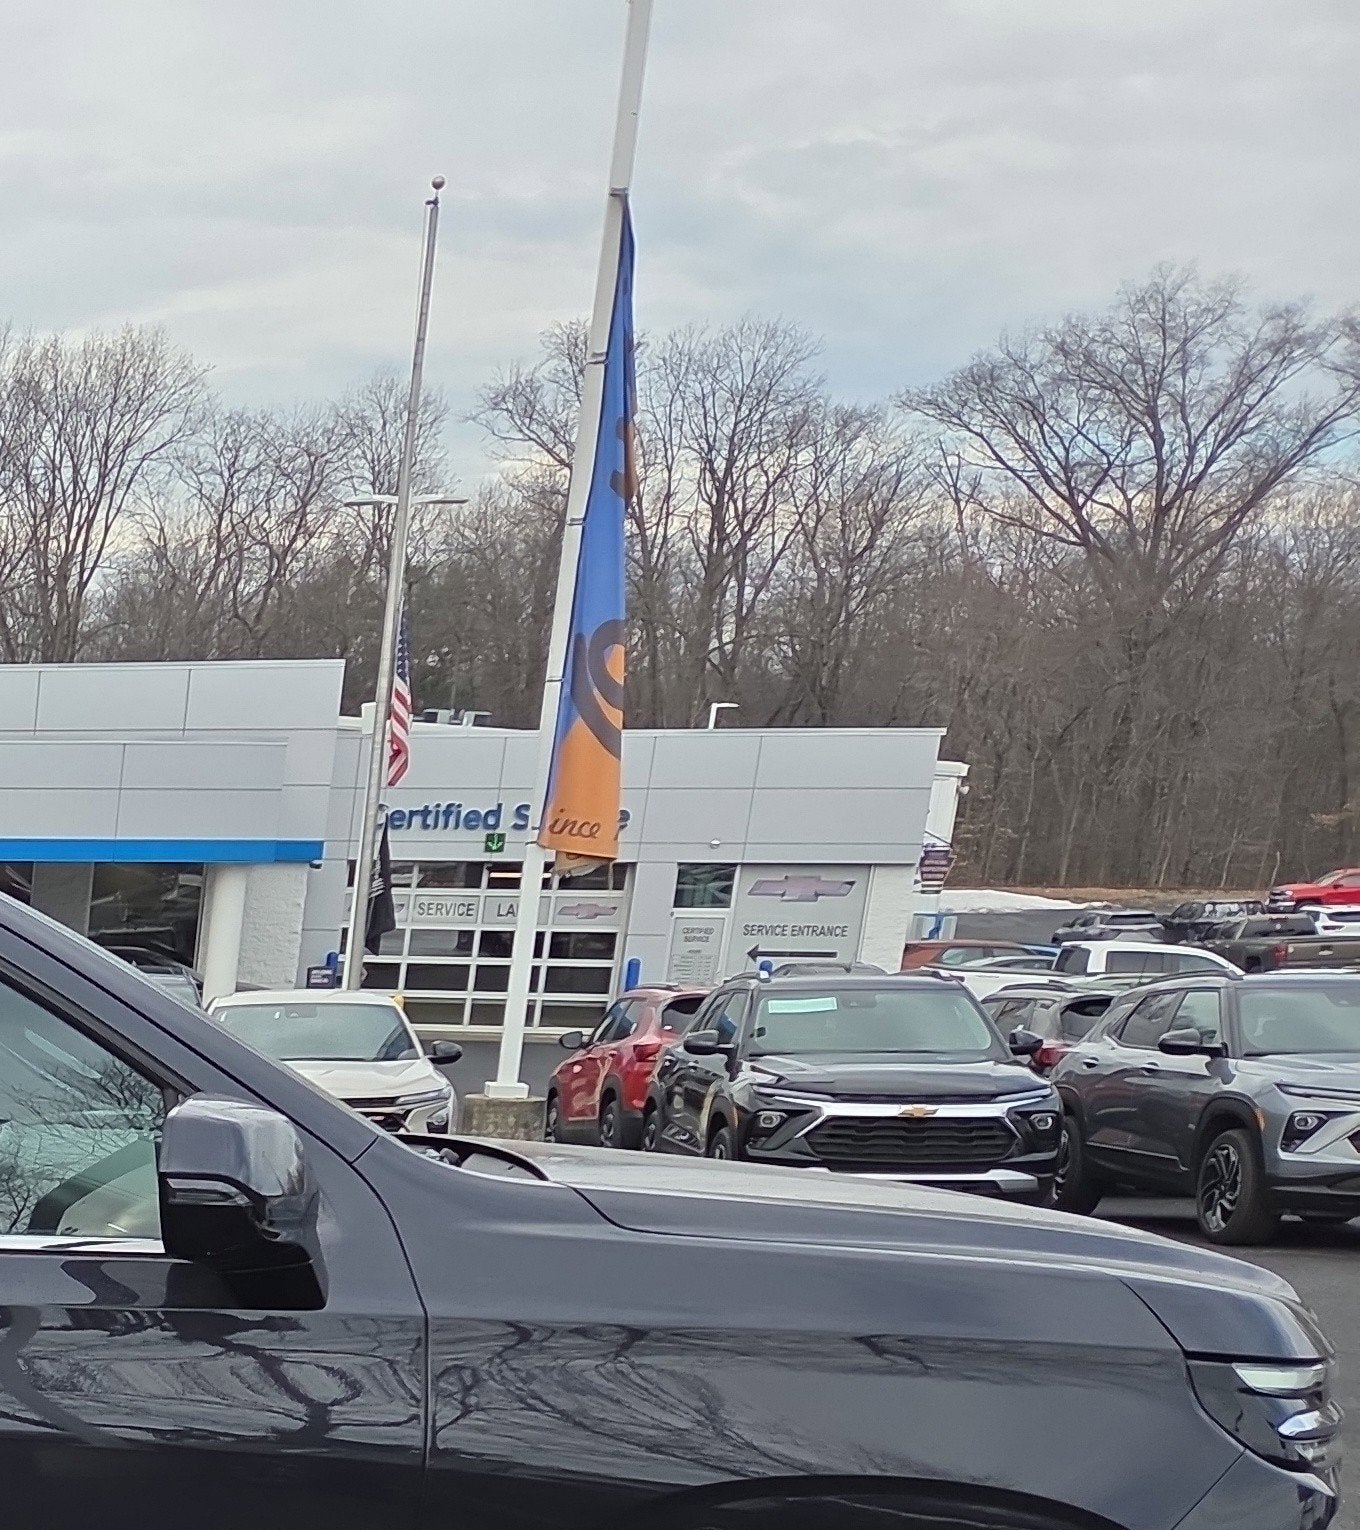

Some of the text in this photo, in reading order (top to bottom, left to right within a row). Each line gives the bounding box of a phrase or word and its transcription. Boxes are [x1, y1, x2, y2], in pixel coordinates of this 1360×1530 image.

[417, 902, 519, 918] SERVICE LA
[742, 924, 849, 938] SERVICE ENTRANCE
